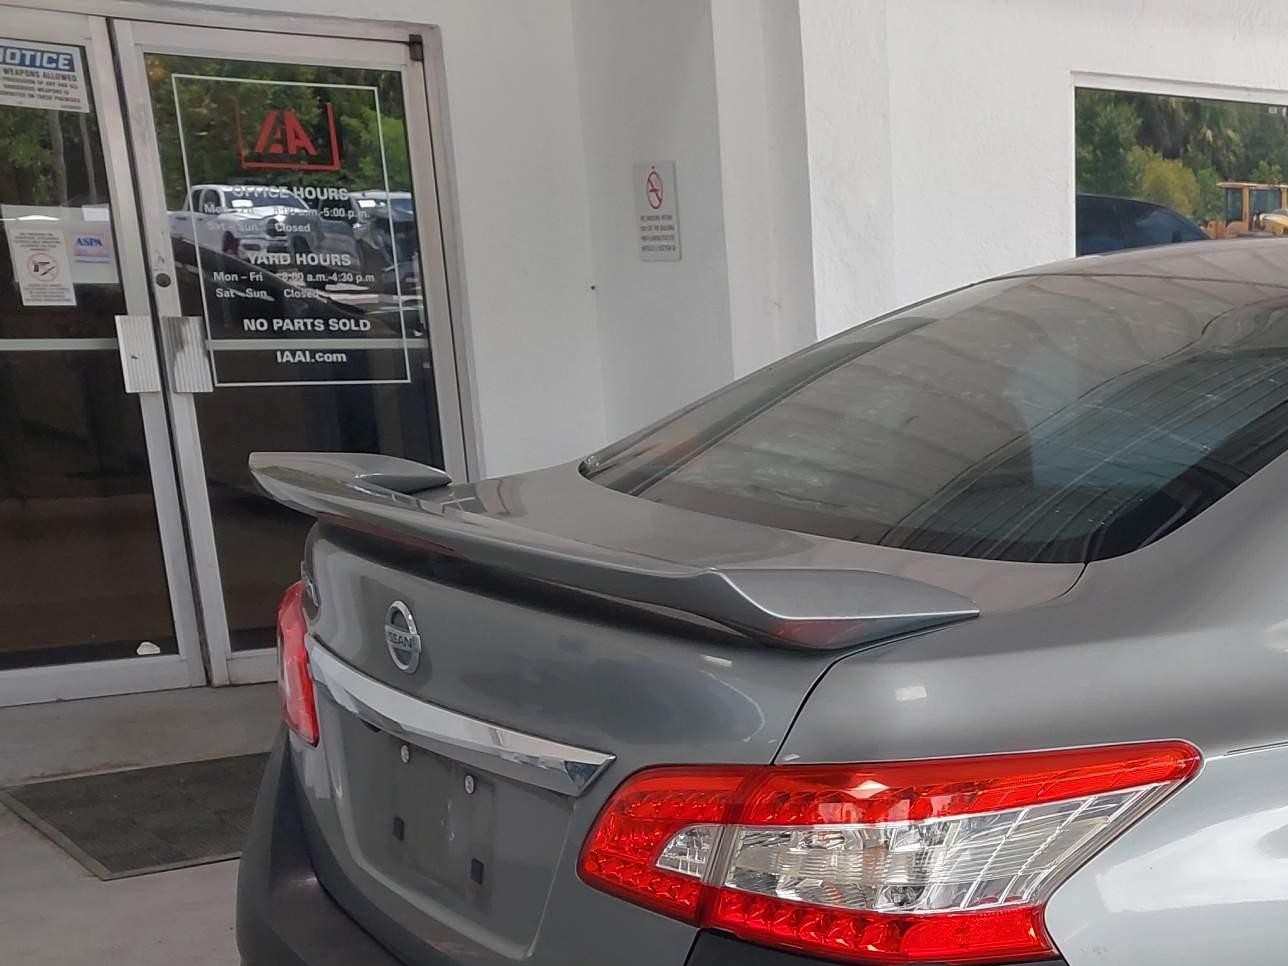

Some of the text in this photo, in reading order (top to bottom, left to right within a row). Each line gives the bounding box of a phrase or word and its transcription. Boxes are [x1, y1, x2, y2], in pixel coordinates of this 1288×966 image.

[232, 186, 349, 200] OFFICE HOURS
[274, 222, 311, 233] Closed
[250, 253, 351, 266] YARD HOURS
[213, 272, 238, 281] Mon
[250, 272, 264, 281] Fri
[215, 289, 235, 298] Sat
[246, 288, 268, 298] Sun
[283, 288, 319, 299] Closed
[243, 318, 371, 331] NO PARTS SOLD
[276, 350, 347, 363] IAAI.com
